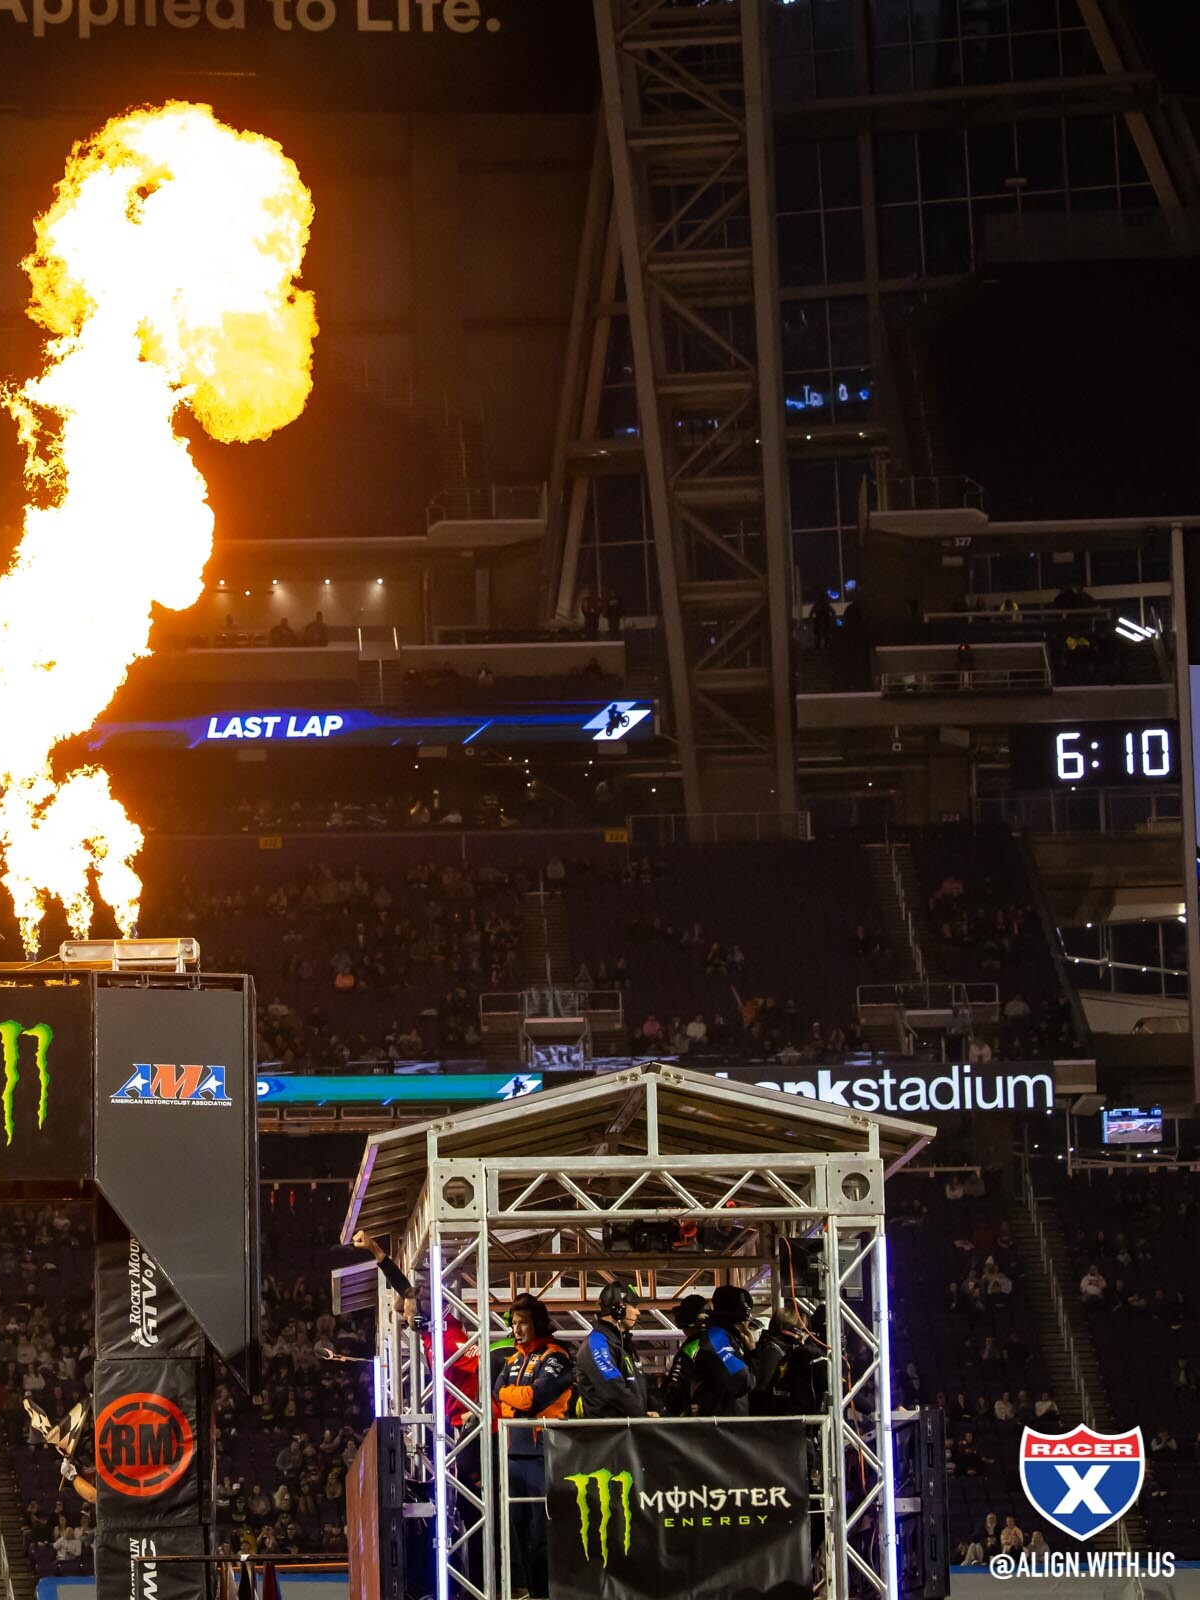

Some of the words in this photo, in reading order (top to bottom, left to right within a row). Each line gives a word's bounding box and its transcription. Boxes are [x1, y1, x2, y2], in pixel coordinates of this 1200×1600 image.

[273, 0, 336, 31] to
[207, 716, 280, 738] LAST
[286, 716, 343, 738] LAP
[1056, 729, 1170, 779] 6:10
[109, 1063, 232, 1100] AMA
[111, 1423, 174, 1466] RM
[639, 1485, 792, 1514] MONSTER
[664, 1515, 768, 1528] ENERGY
